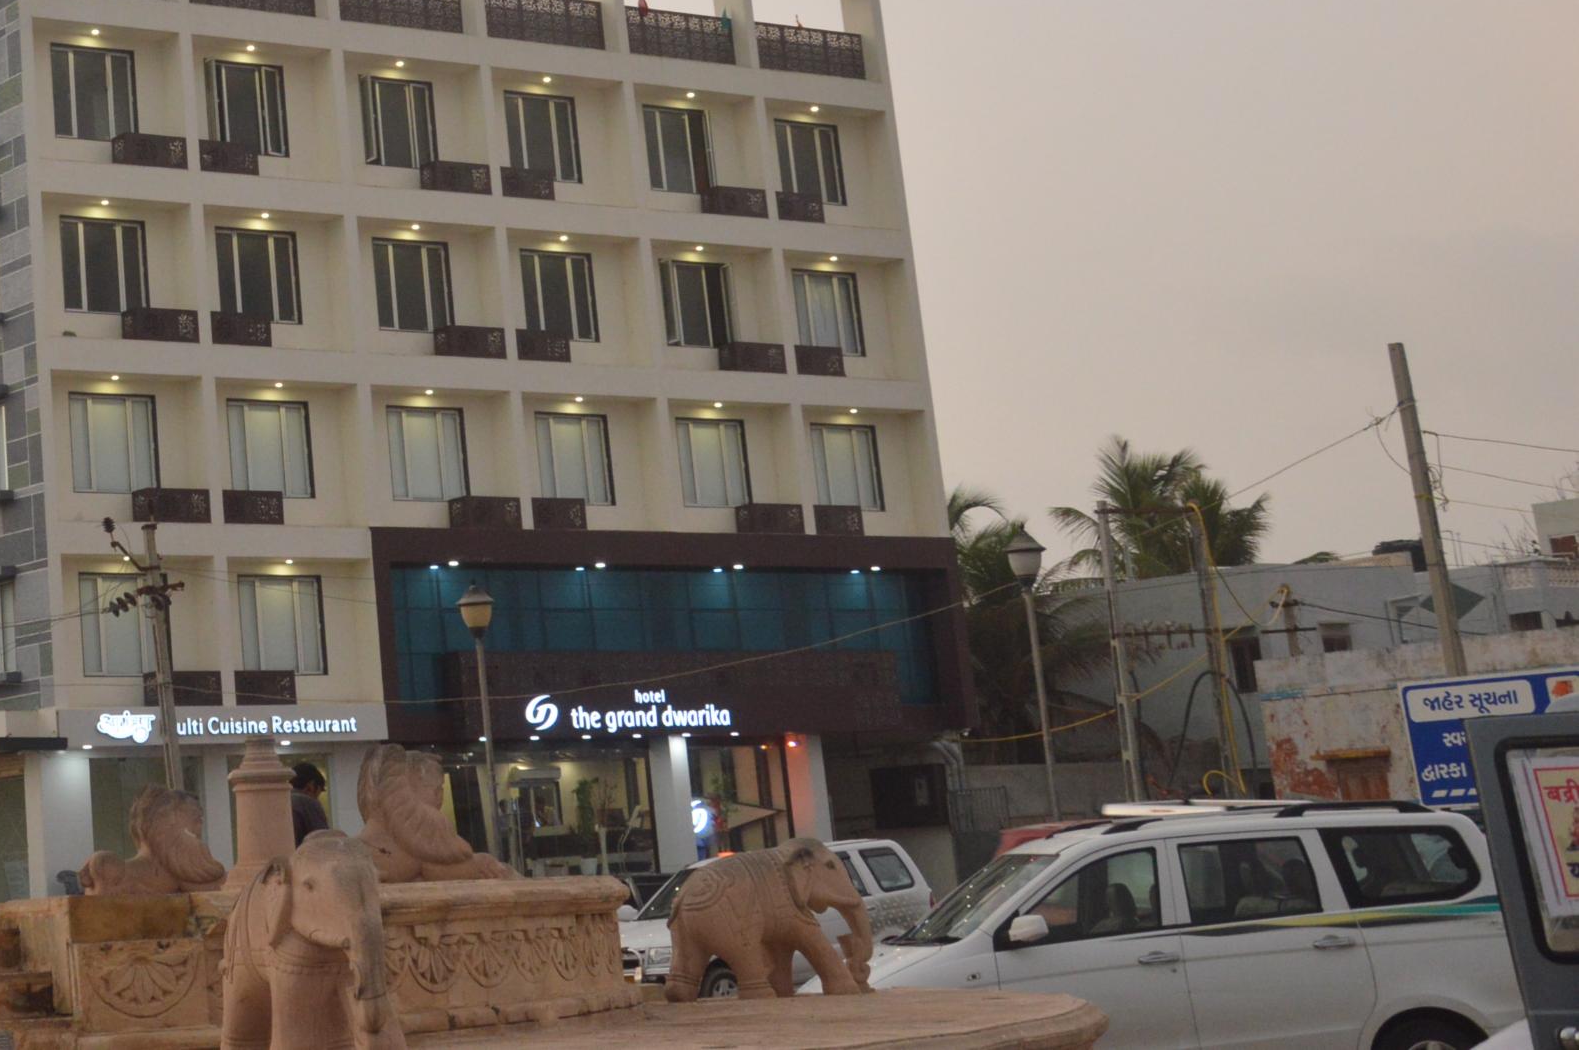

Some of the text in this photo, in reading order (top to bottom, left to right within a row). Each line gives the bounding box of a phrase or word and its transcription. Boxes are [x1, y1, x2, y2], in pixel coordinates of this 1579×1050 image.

[634, 688, 666, 704] hotel
[207, 716, 269, 735] Cuisine
[271, 715, 358, 734] Restaurant
[570, 703, 731, 733] the grand dwarika
